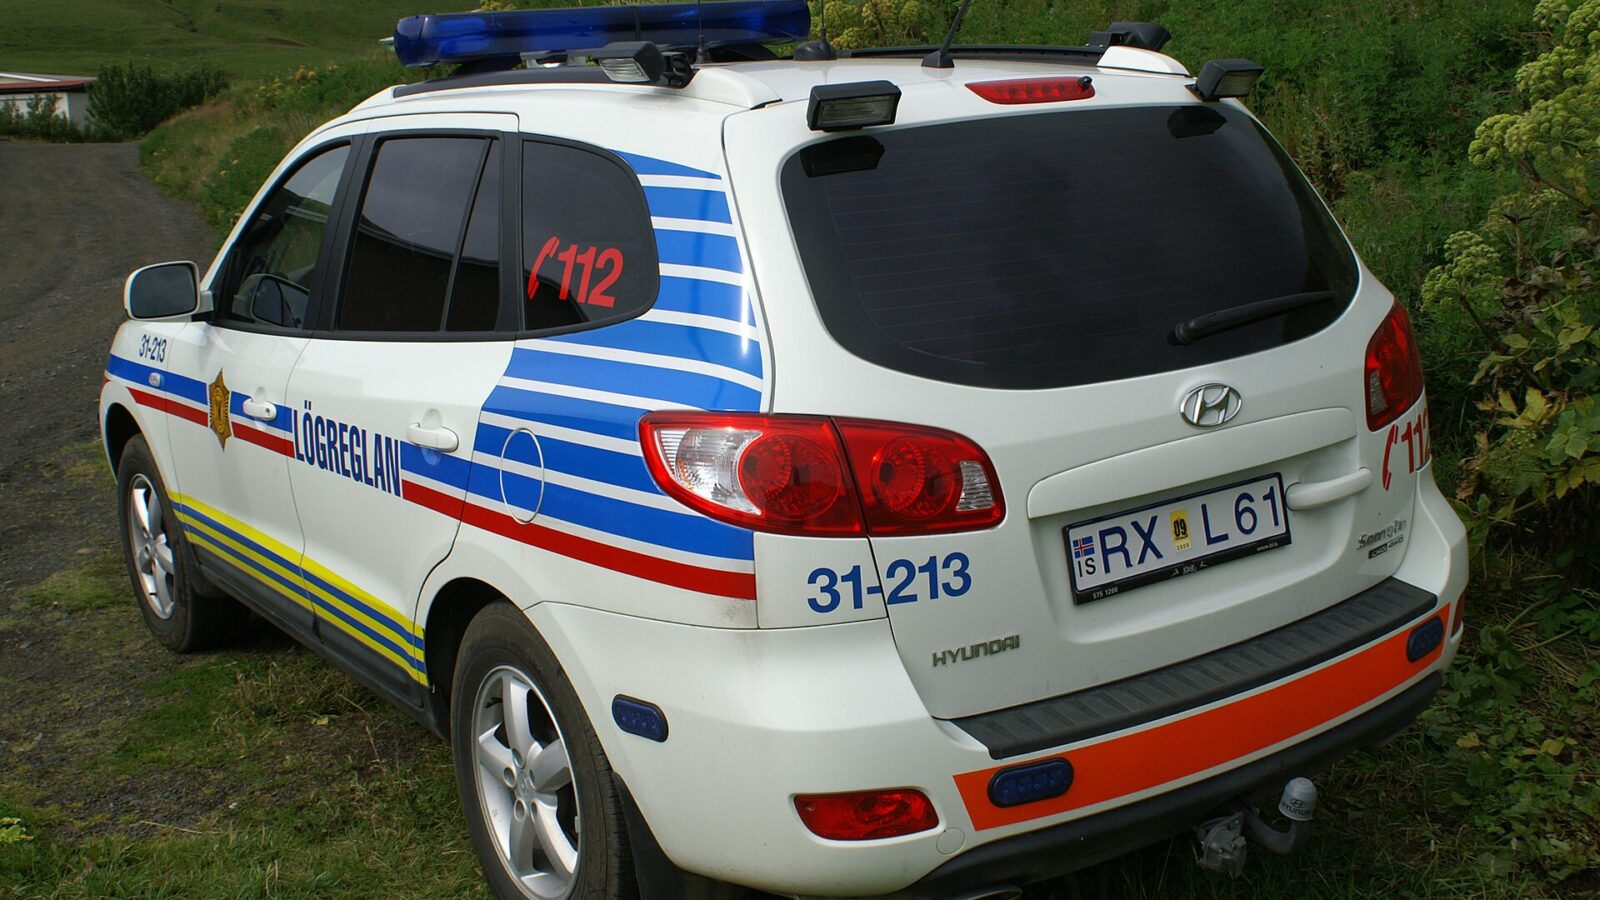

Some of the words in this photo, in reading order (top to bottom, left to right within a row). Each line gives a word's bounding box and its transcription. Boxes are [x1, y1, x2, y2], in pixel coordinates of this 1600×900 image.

[558, 244, 624, 309] 112
[139, 334, 167, 363] 31-213
[293, 400, 401, 498] LÖGREGLAN
[1098, 515, 1164, 574] RX
[1201, 486, 1280, 545] L61
[1173, 518, 1188, 537] 09
[807, 552, 972, 613] 31-213
[1073, 557, 1096, 577] IS
[932, 634, 1020, 667] HYUNDAI
